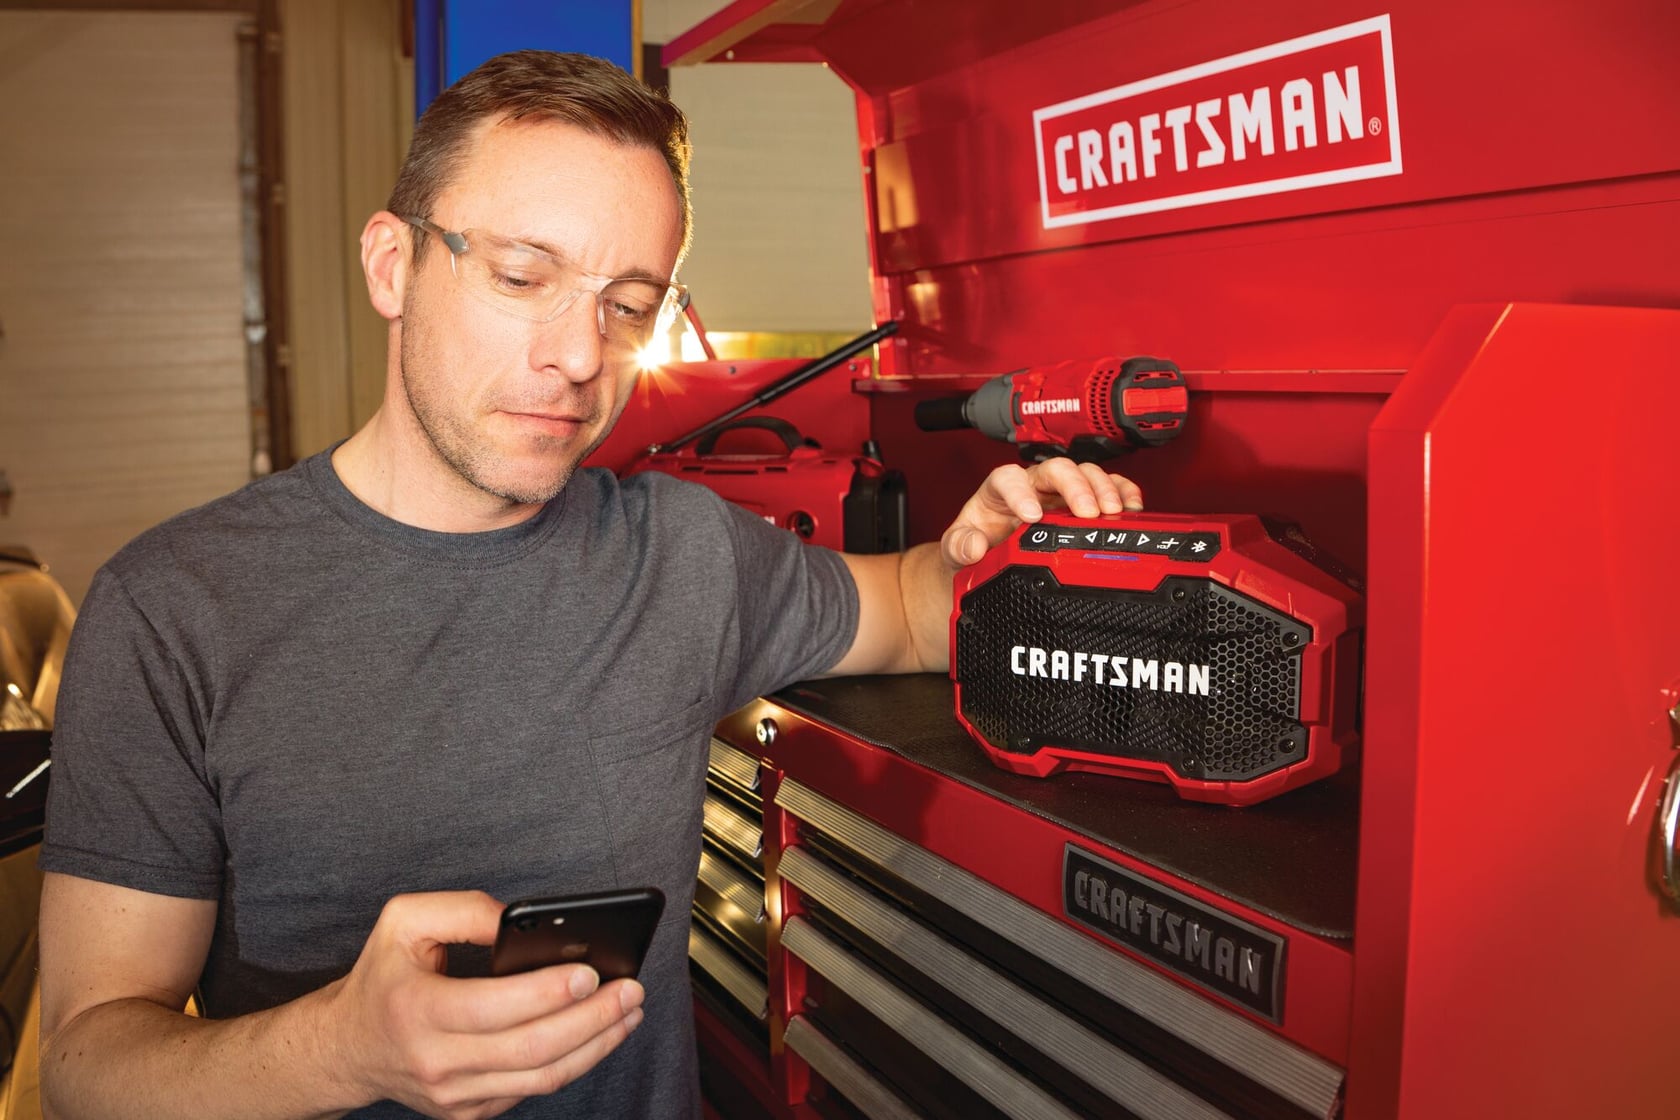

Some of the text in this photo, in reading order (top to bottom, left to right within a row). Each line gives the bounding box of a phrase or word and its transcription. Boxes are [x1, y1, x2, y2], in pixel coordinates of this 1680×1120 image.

[1022, 398, 1080, 415] CRAFTSMAN
[1010, 645, 1210, 696] CRAFTSMAN
[1074, 870, 1262, 995] CRAFTSMAN
